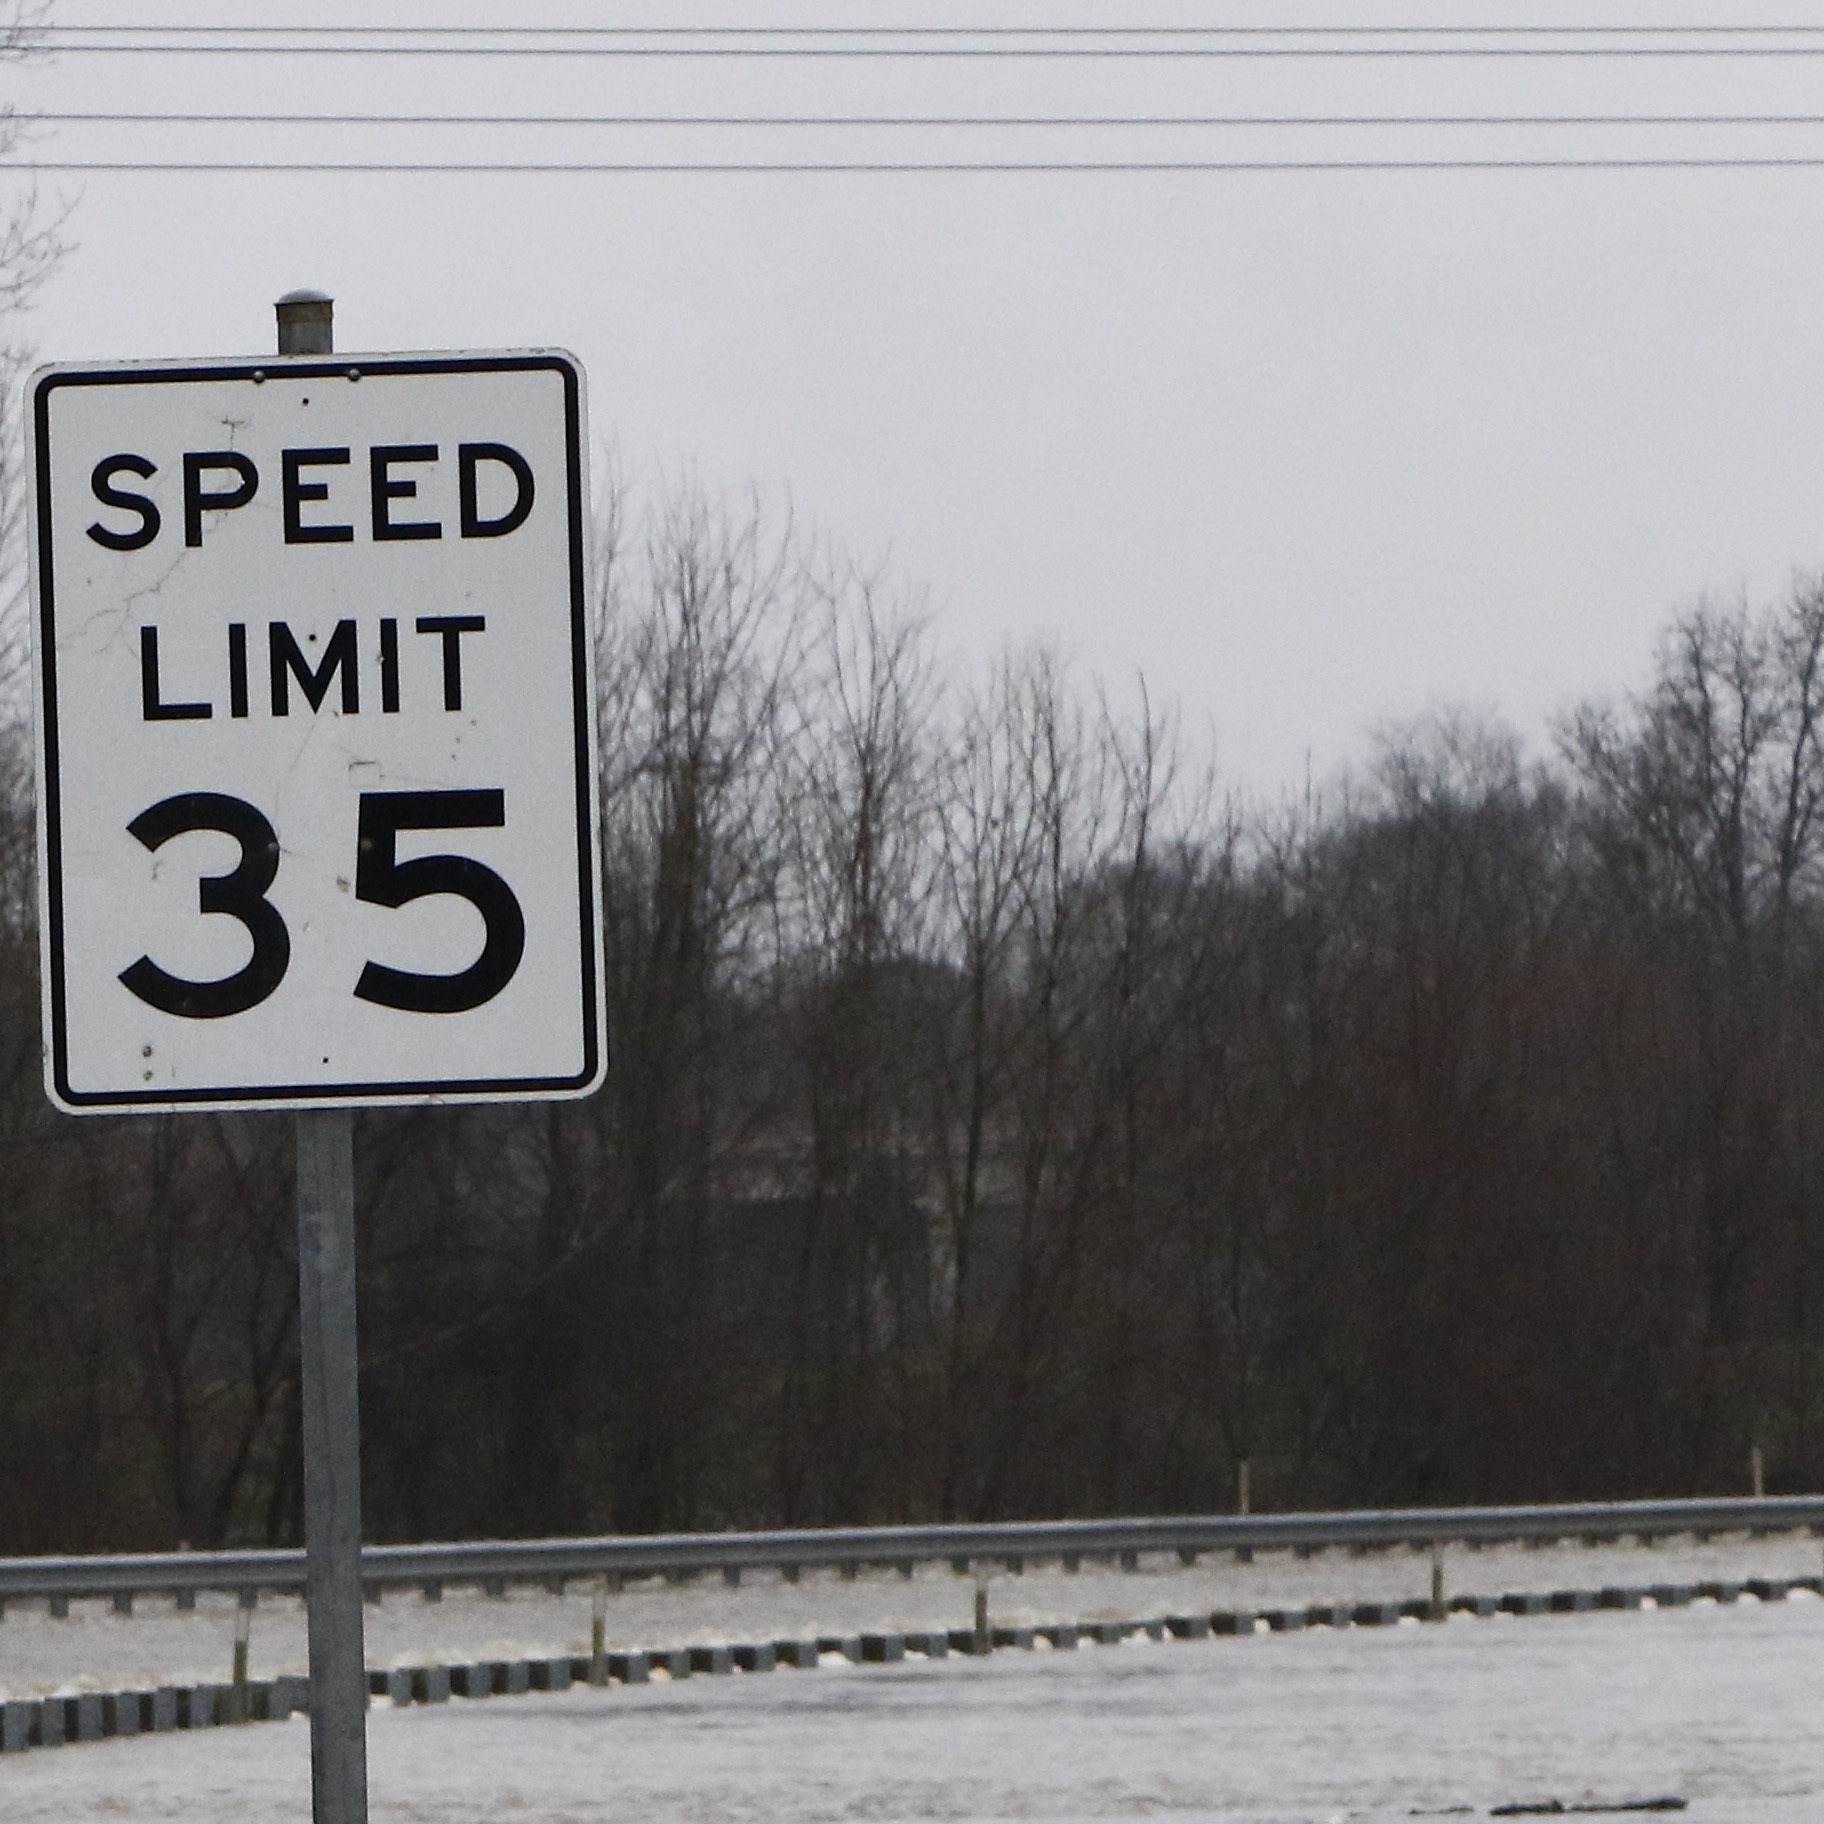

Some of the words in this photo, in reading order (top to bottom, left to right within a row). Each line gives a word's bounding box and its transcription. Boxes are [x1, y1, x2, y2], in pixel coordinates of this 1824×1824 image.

[85, 442, 536, 552] SPEED
[140, 615, 486, 722] LIMIT
[116, 788, 526, 1020] 35
